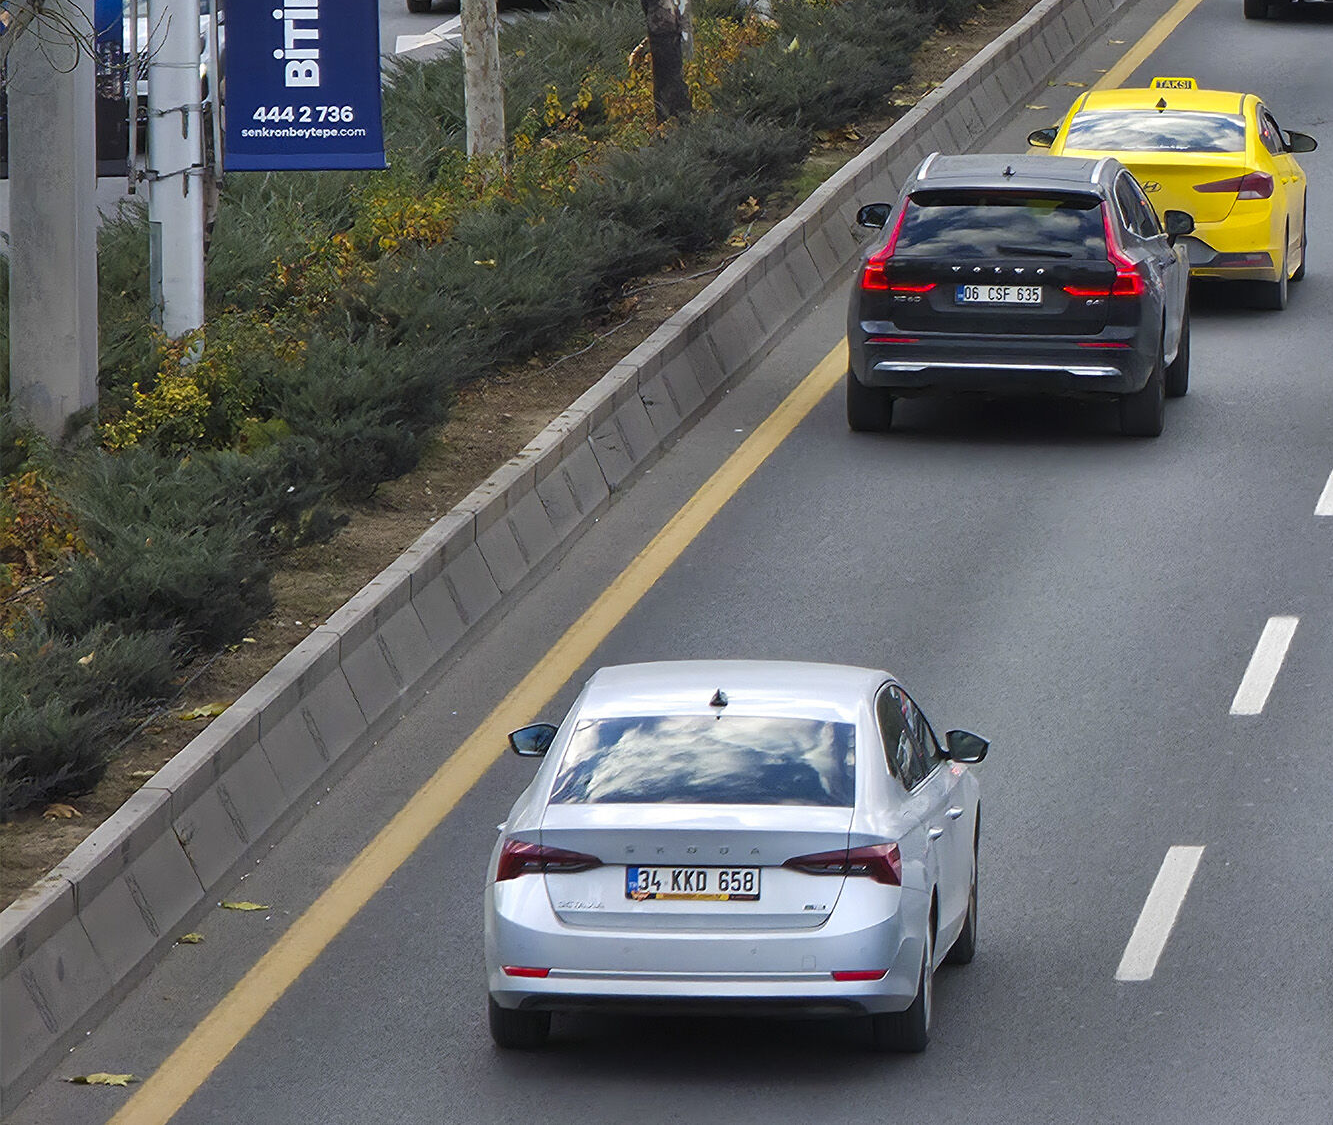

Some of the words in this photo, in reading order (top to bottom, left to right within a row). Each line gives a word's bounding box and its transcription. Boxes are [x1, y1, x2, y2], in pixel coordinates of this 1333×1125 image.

[253, 106, 294, 123] 444
[299, 106, 312, 123] 2
[315, 106, 354, 123] 736
[241, 127, 366, 139] senkronbeytepe.com
[964, 287, 980, 299] 06
[987, 288, 1011, 300] CSF
[1016, 289, 1041, 302] 635
[638, 869, 662, 892] 34
[670, 870, 707, 893] KKD
[718, 870, 755, 893] 658
